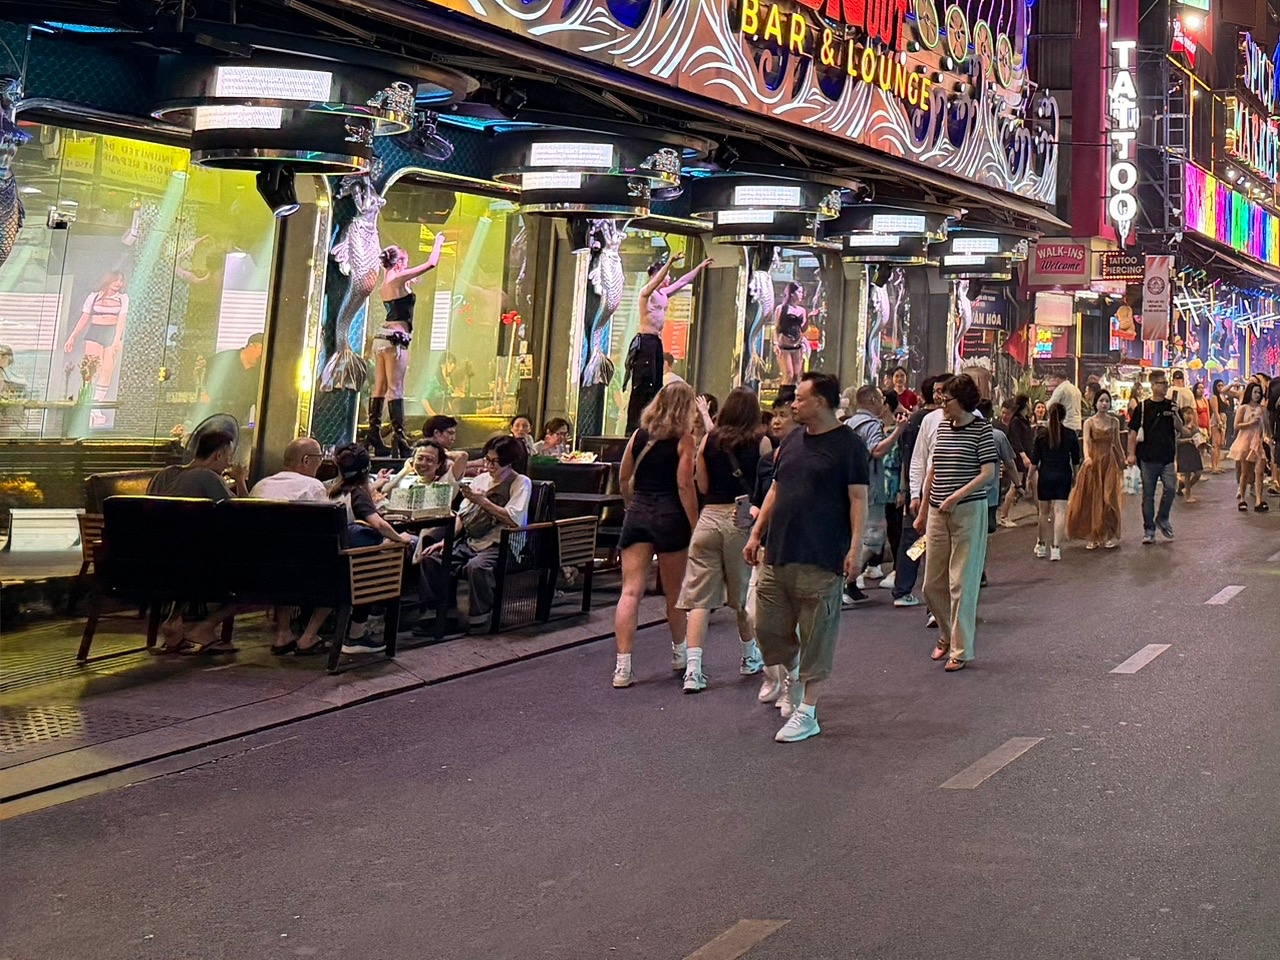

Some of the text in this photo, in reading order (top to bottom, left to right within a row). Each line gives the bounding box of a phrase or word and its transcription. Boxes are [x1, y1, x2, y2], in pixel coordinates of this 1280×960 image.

[820, 28, 835, 66] &
[847, 39, 933, 111] LOUNGE
[1108, 41, 1138, 221] TATTOO
[1037, 246, 1084, 260] WALK-INS
[1041, 260, 1080, 271] Welcome
[1109, 256, 1138, 265] TATTOO
[1107, 265, 1142, 274] PIERCING
